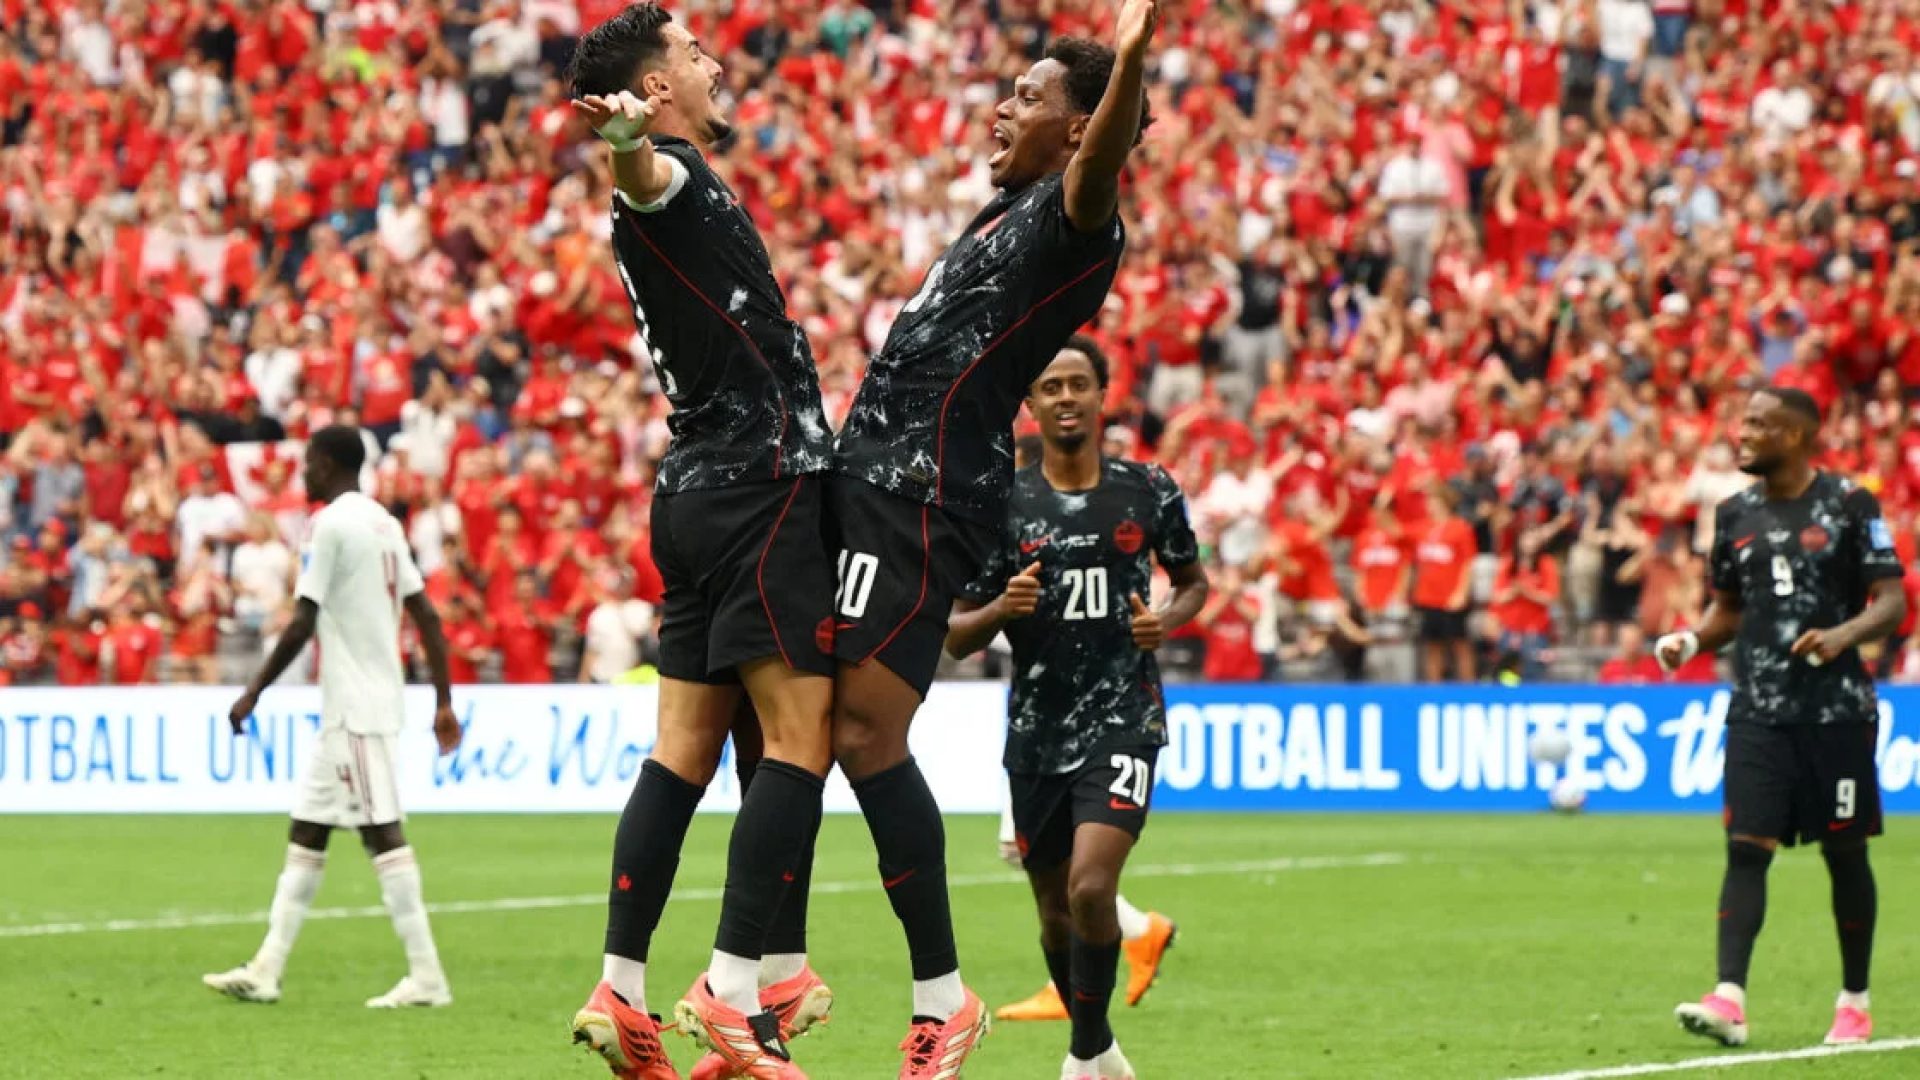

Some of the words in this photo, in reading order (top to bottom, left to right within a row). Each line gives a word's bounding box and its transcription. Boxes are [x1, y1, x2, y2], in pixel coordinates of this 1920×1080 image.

[1062, 566, 1109, 621] 20
[1770, 555, 1795, 596] 9
[0, 714, 179, 782] TBALL
[548, 704, 658, 786] Wo
[1154, 702, 1401, 790] OTBALL
[1417, 702, 1648, 792] UNITES
[1109, 753, 1150, 808] 20
[1835, 777, 1857, 819] 9
